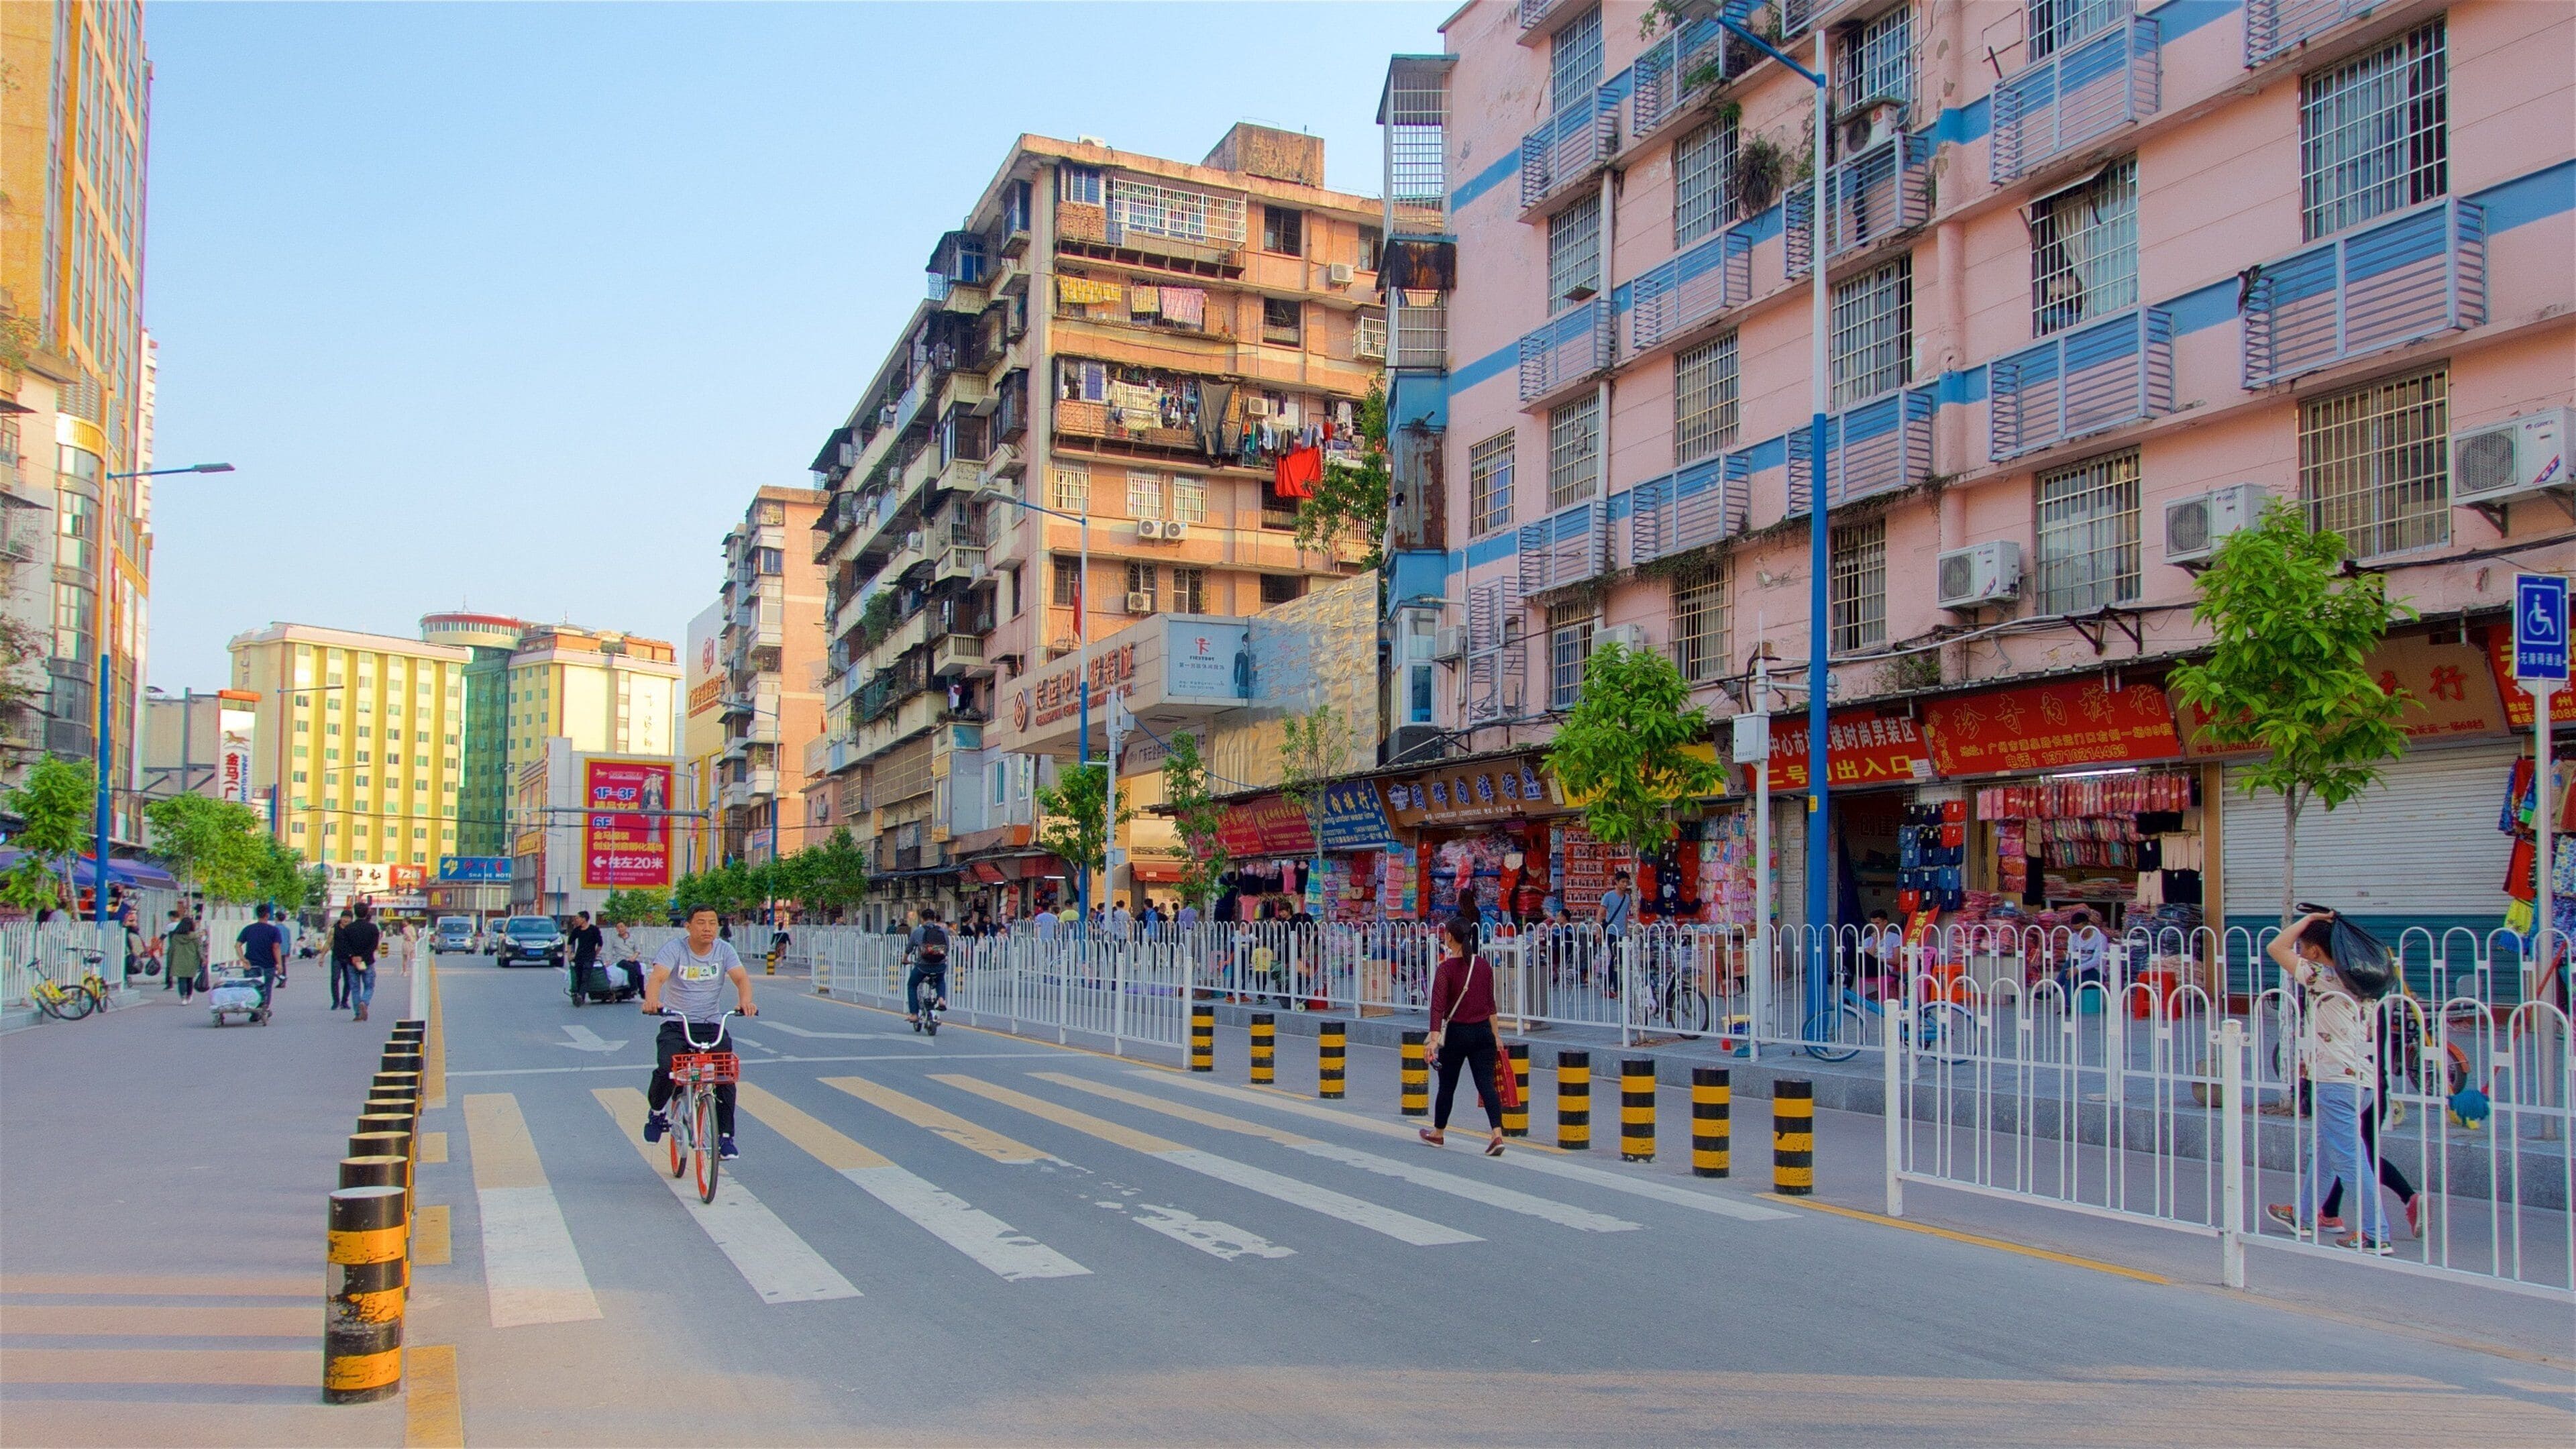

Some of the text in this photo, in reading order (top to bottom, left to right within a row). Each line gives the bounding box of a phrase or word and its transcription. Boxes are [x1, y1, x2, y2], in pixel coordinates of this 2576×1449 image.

[2520, 651, 2563, 667] 无障碍通道
[594, 787, 637, 800] 1F-3F
[593, 816, 612, 828] 6F
